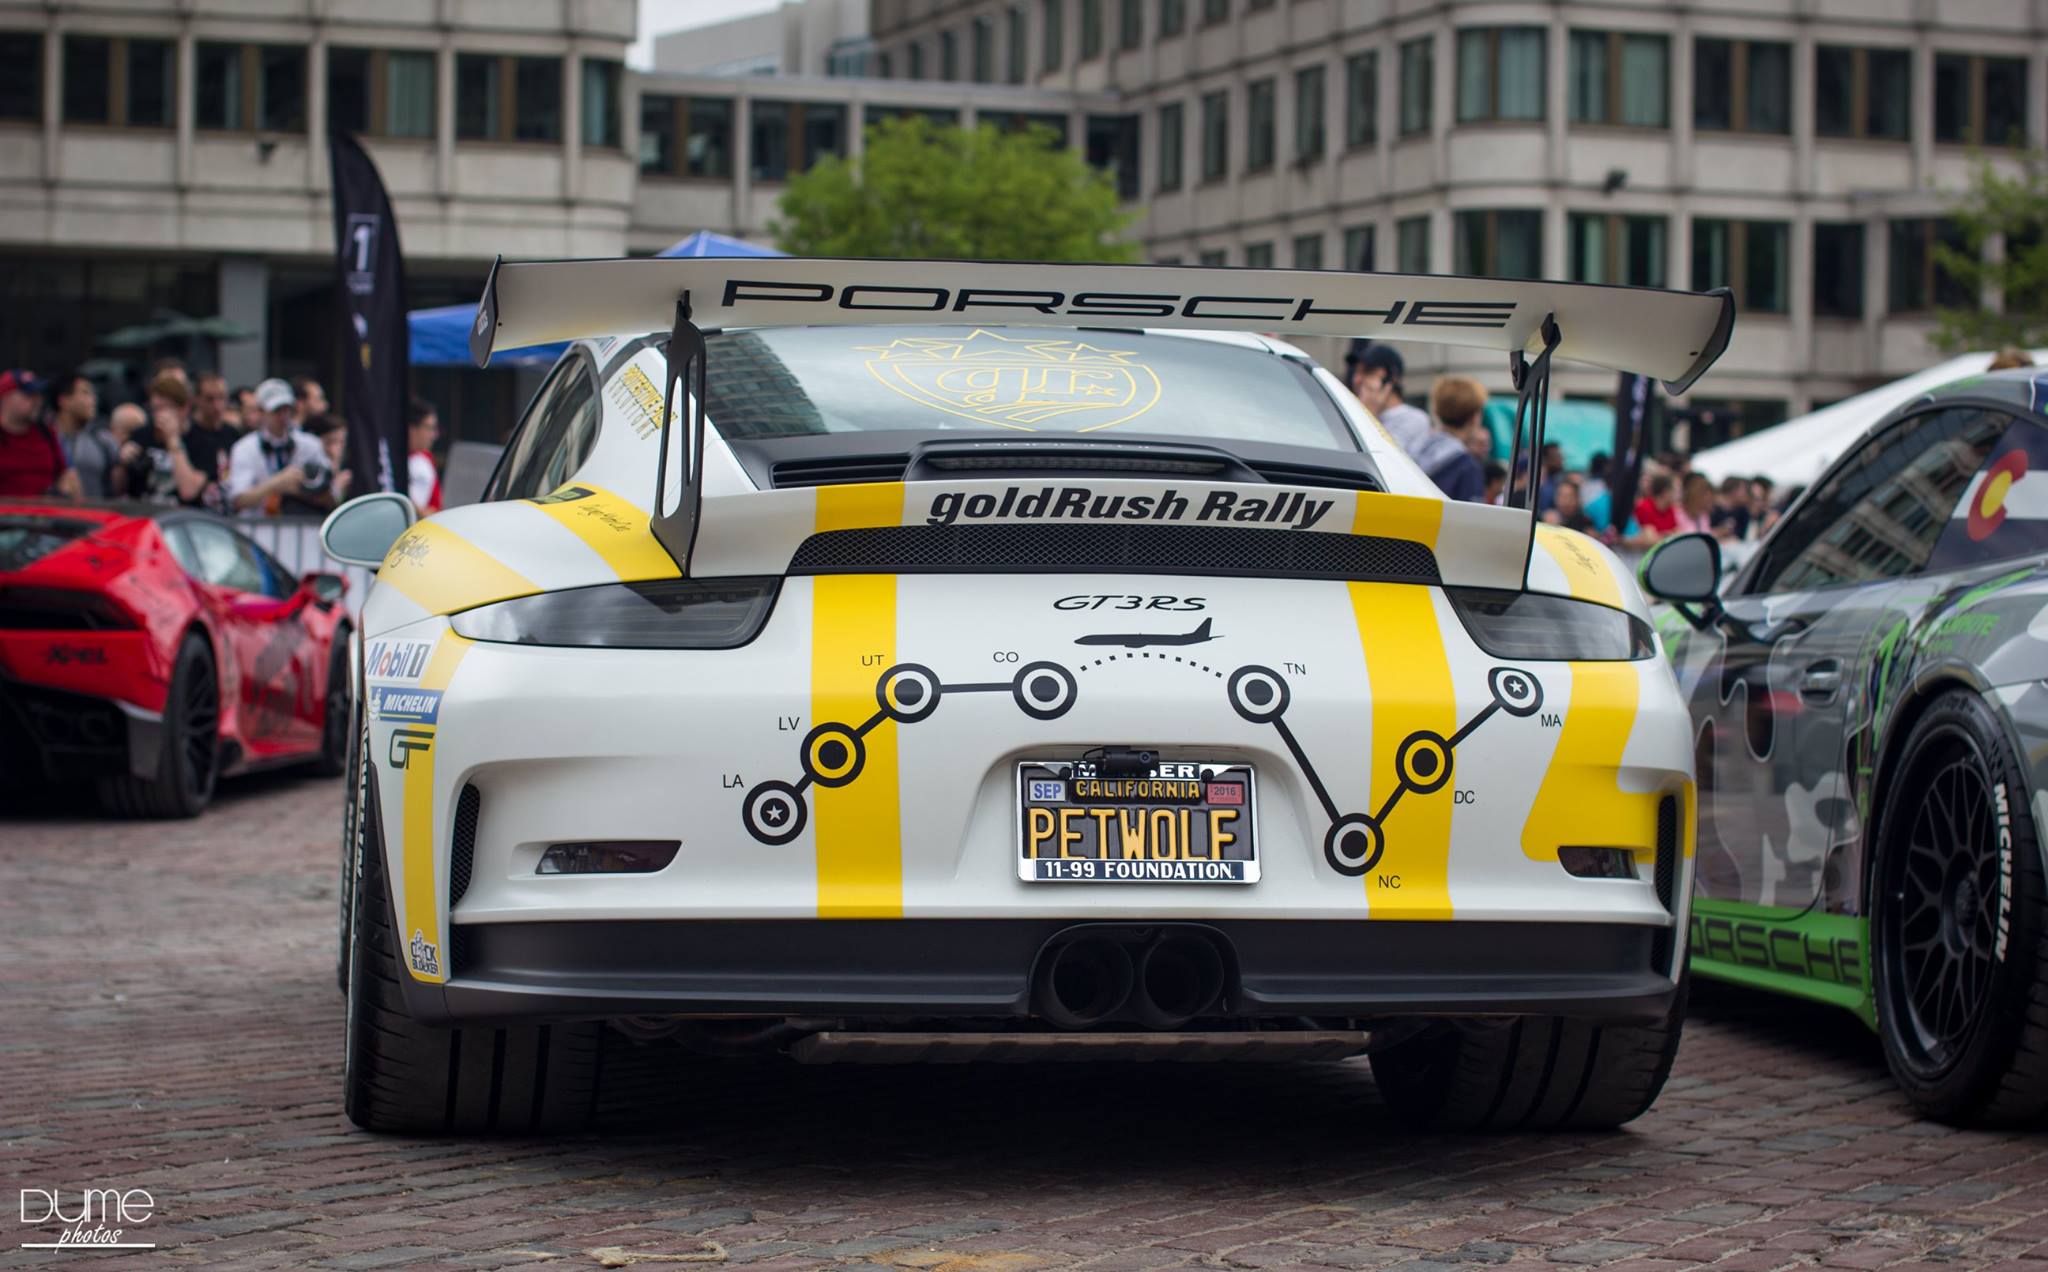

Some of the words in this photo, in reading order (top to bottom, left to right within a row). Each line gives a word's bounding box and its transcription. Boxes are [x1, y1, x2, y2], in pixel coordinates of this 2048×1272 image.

[721, 279, 1518, 329] PORSCHE
[927, 486, 1189, 526] goldRush
[1196, 490, 1335, 530] Rally
[366, 642, 415, 677] Mobil
[861, 655, 885, 667] UT
[992, 651, 1019, 663] CO
[1283, 662, 1307, 676] TN
[383, 694, 438, 714] MICHELIN
[778, 717, 800, 731] LV
[1541, 714, 1562, 728] MA
[1078, 763, 1195, 779] MER
[722, 774, 744, 789] LA
[1034, 783, 1062, 799] SEP
[1075, 780, 1200, 798] CALIFORNIA
[1214, 786, 1236, 796] 2016
[1453, 790, 1476, 805] DC
[1028, 808, 1240, 860] PETWOLF
[1045, 861, 1096, 878] 11-99
[1994, 782, 2013, 963] MICHELIN
[1378, 875, 1402, 889] NC
